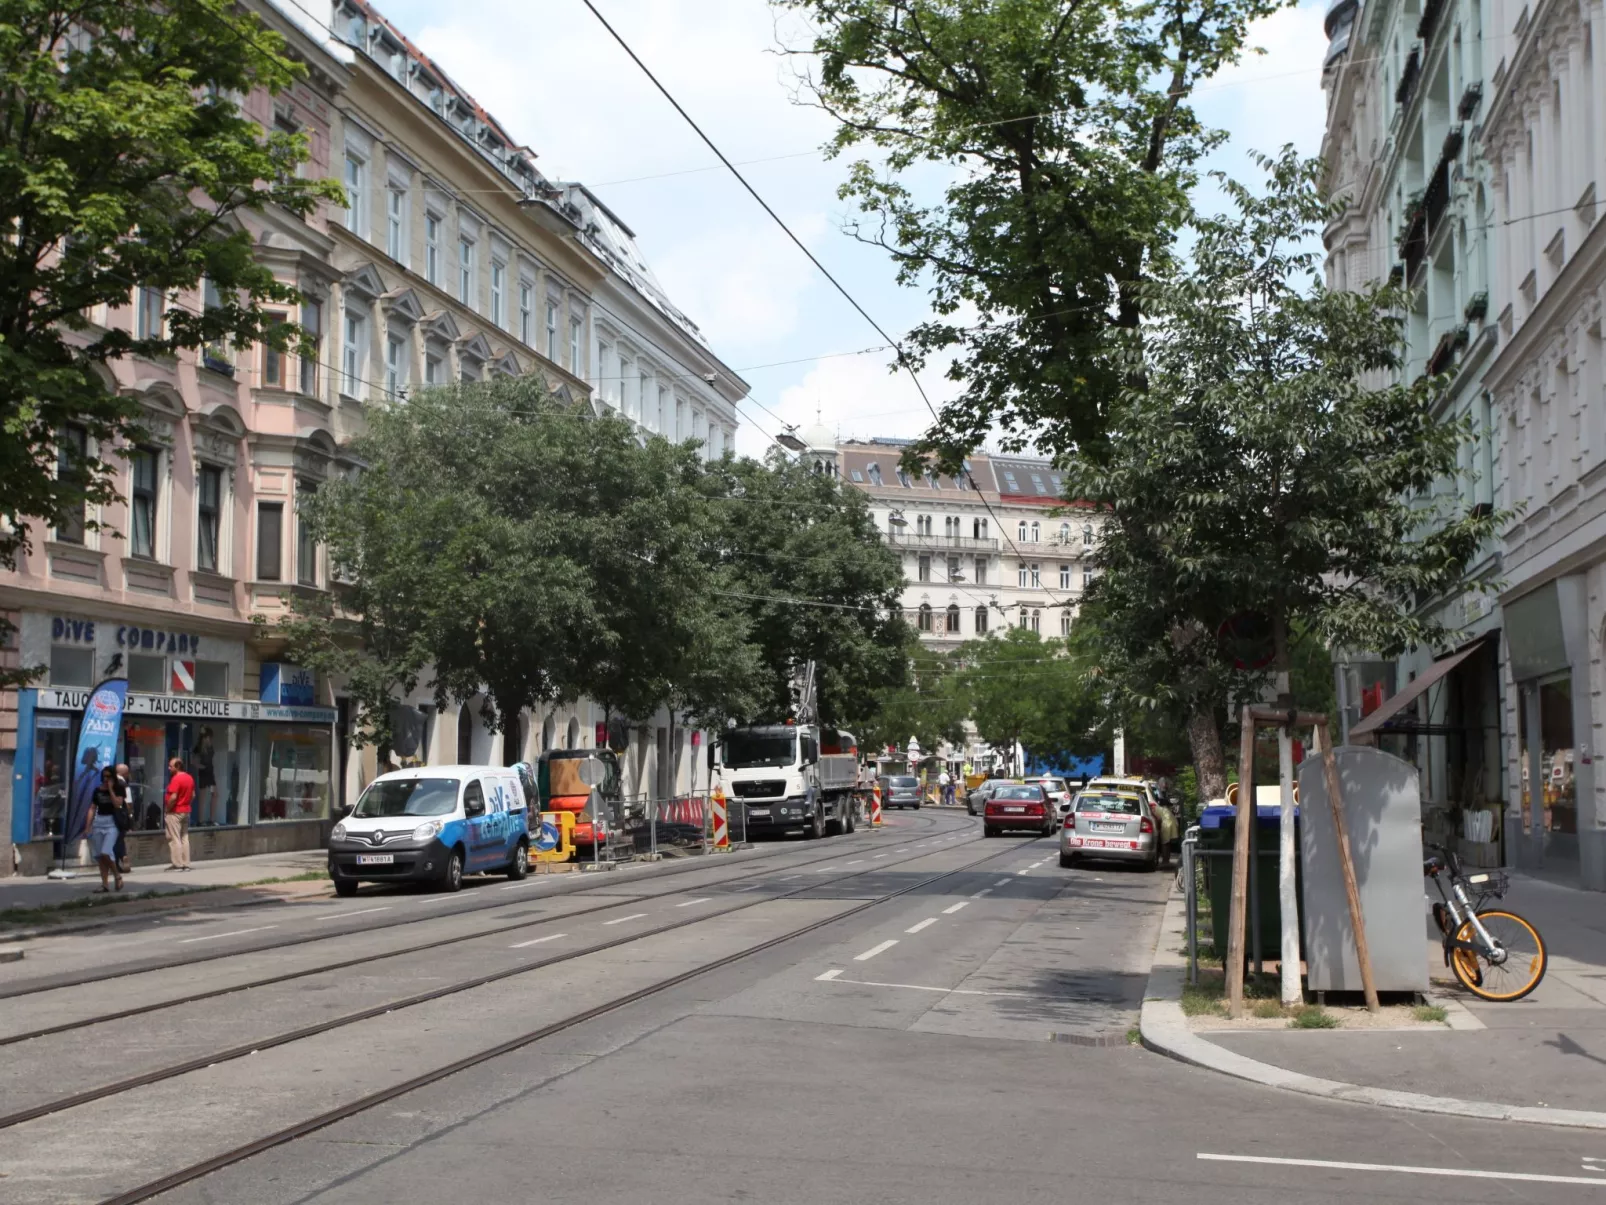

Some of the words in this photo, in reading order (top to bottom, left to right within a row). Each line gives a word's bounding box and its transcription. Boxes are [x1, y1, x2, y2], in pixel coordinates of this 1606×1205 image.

[150, 698, 230, 716] TAUCHSCHULE
[86, 719, 115, 733] PADI
[1070, 837, 1081, 846] Die
[1083, 838, 1104, 848] Krone
